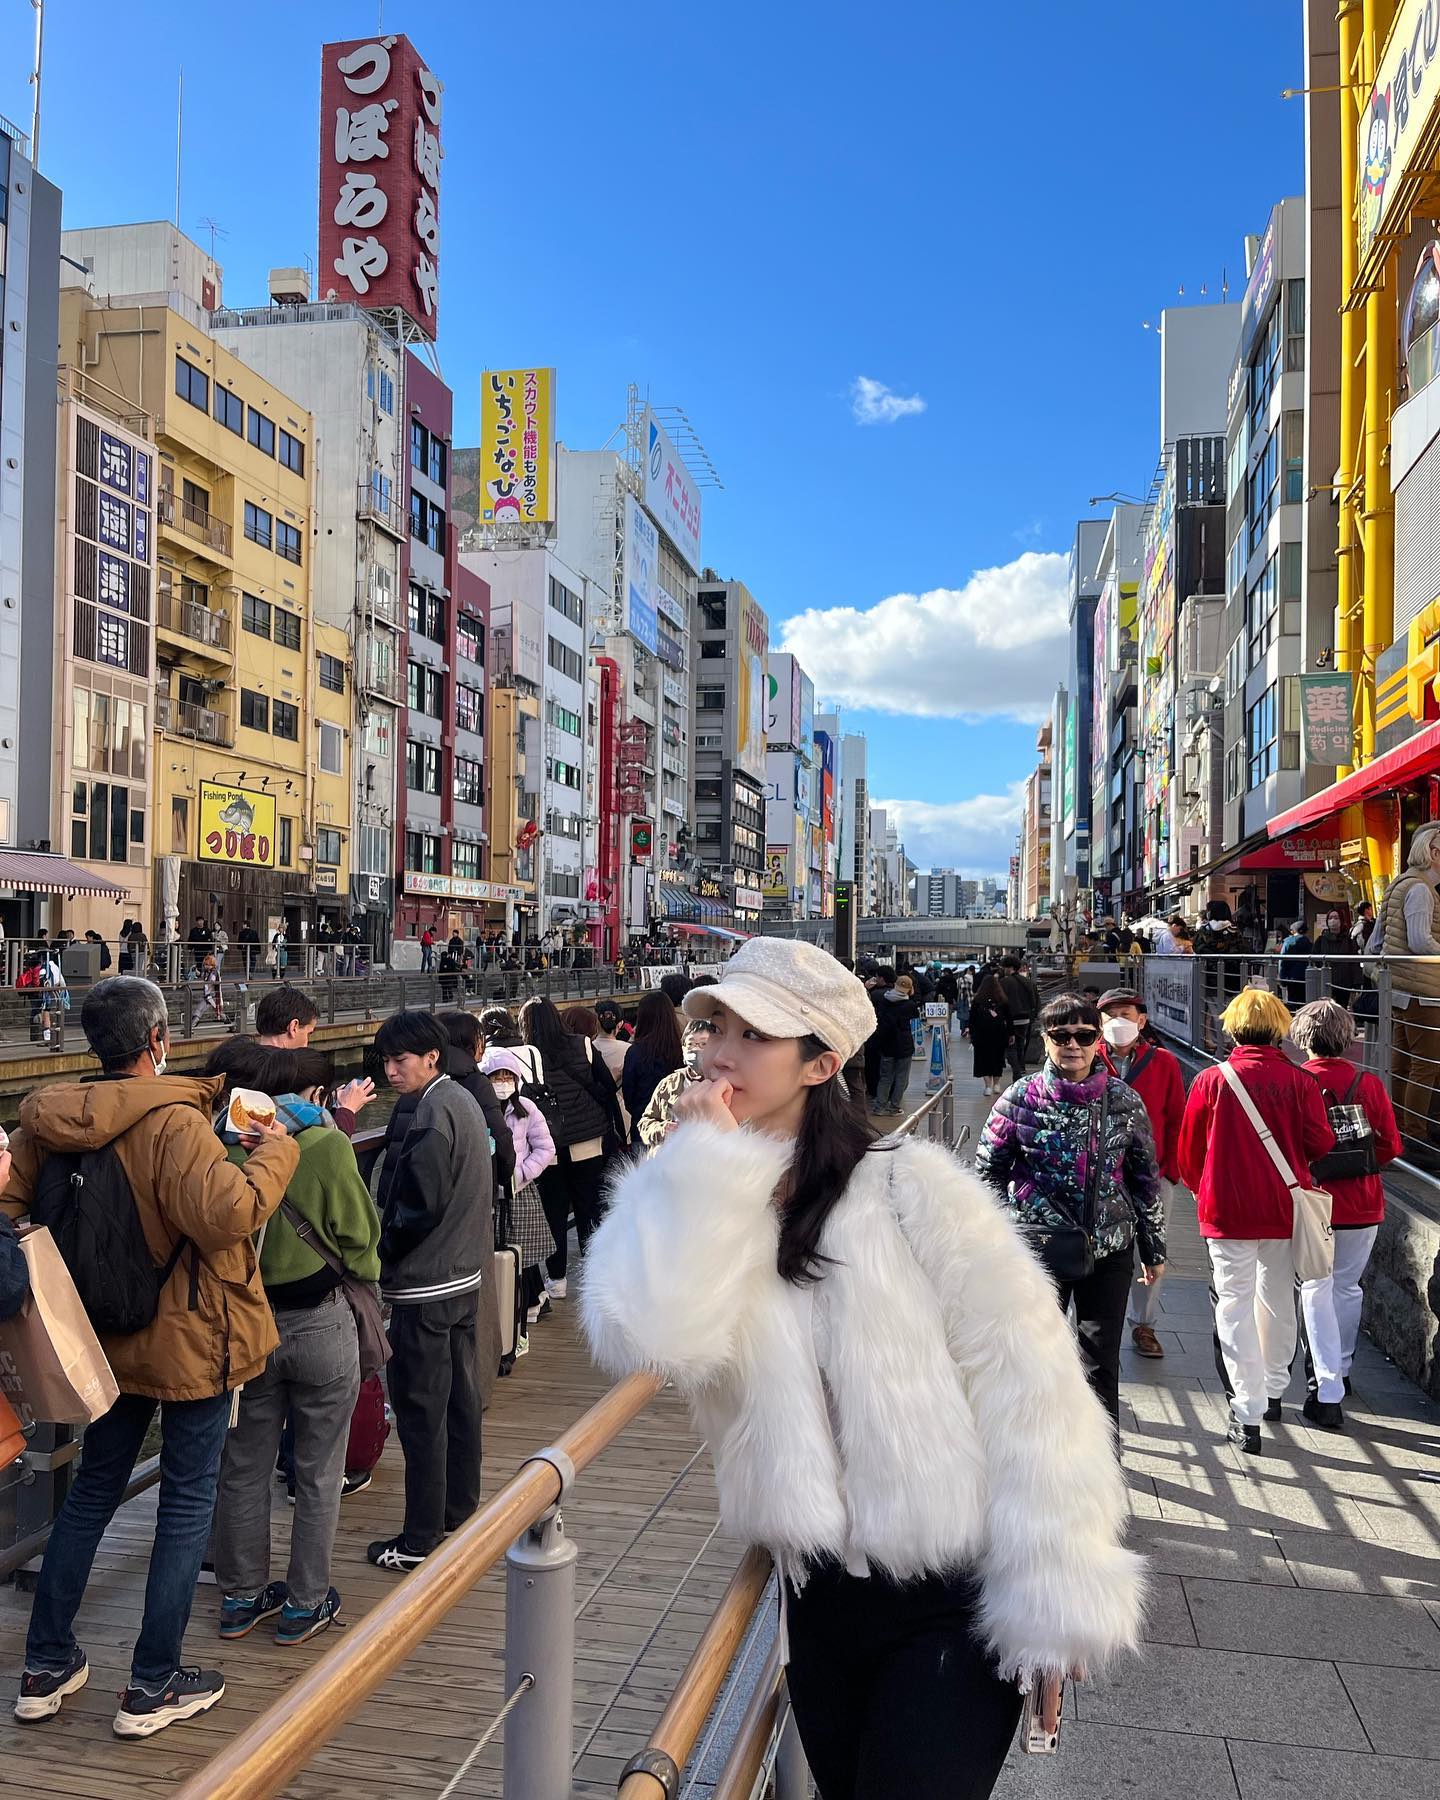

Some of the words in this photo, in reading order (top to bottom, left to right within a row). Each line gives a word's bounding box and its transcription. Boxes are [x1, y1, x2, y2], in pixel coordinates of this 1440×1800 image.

[333, 35, 399, 295] づぼらや
[491, 373, 519, 498] いちごなび
[1306, 686, 1347, 722] 薬
[1308, 725, 1349, 734] Medicine
[203, 791, 226, 802] Fishing
[927, 1008, 935, 1016] 13
[937, 1007, 947, 1016] 30
